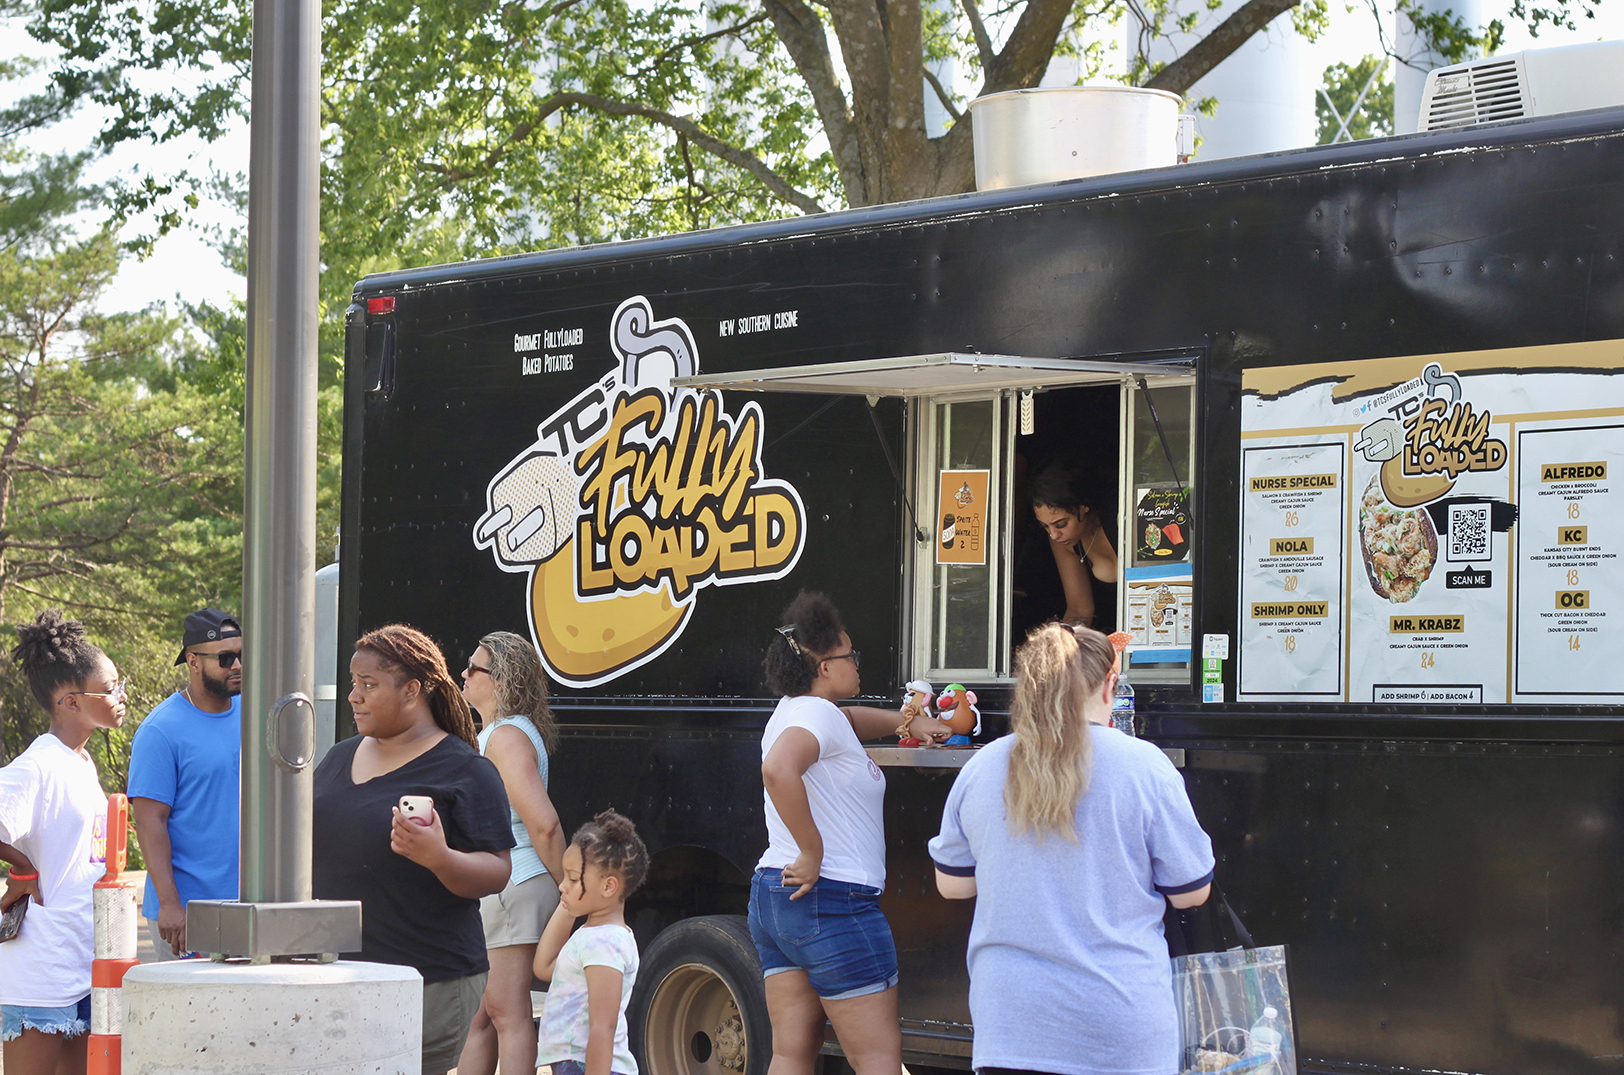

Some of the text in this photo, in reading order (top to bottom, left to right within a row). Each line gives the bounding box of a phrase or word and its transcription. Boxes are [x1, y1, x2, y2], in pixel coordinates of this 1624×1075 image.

[719, 310, 799, 337] NEW SOUTHERN CUISINE
[514, 333, 541, 352] GOURMET
[522, 354, 574, 376] BAKED POTATOES
[1404, 398, 1489, 454] Fully
[577, 392, 757, 538] Fully
[1404, 440, 1506, 477] LOADED
[1544, 466, 1604, 480] ALFREDO
[1252, 476, 1334, 489] NURSE SPECIAL
[1285, 511, 1299, 527] 26
[1567, 503, 1580, 519] 18
[579, 491, 799, 595] LOADED
[1565, 530, 1582, 542] KC
[960, 540, 965, 549] 2
[1276, 541, 1308, 552] NOLA
[1284, 575, 1298, 591] 20
[1452, 575, 1486, 585] SCAN ME
[1566, 569, 1579, 586] 18
[1561, 593, 1584, 607] OG
[1254, 605, 1325, 616] SHRIMP ONLY
[1394, 619, 1460, 630] MR. KRABZ
[1284, 635, 1296, 651] 18
[1568, 634, 1580, 651] 14
[1421, 652, 1434, 669] 24
[1421, 691, 1426, 699] 6
[1468, 691, 1473, 699] 4
